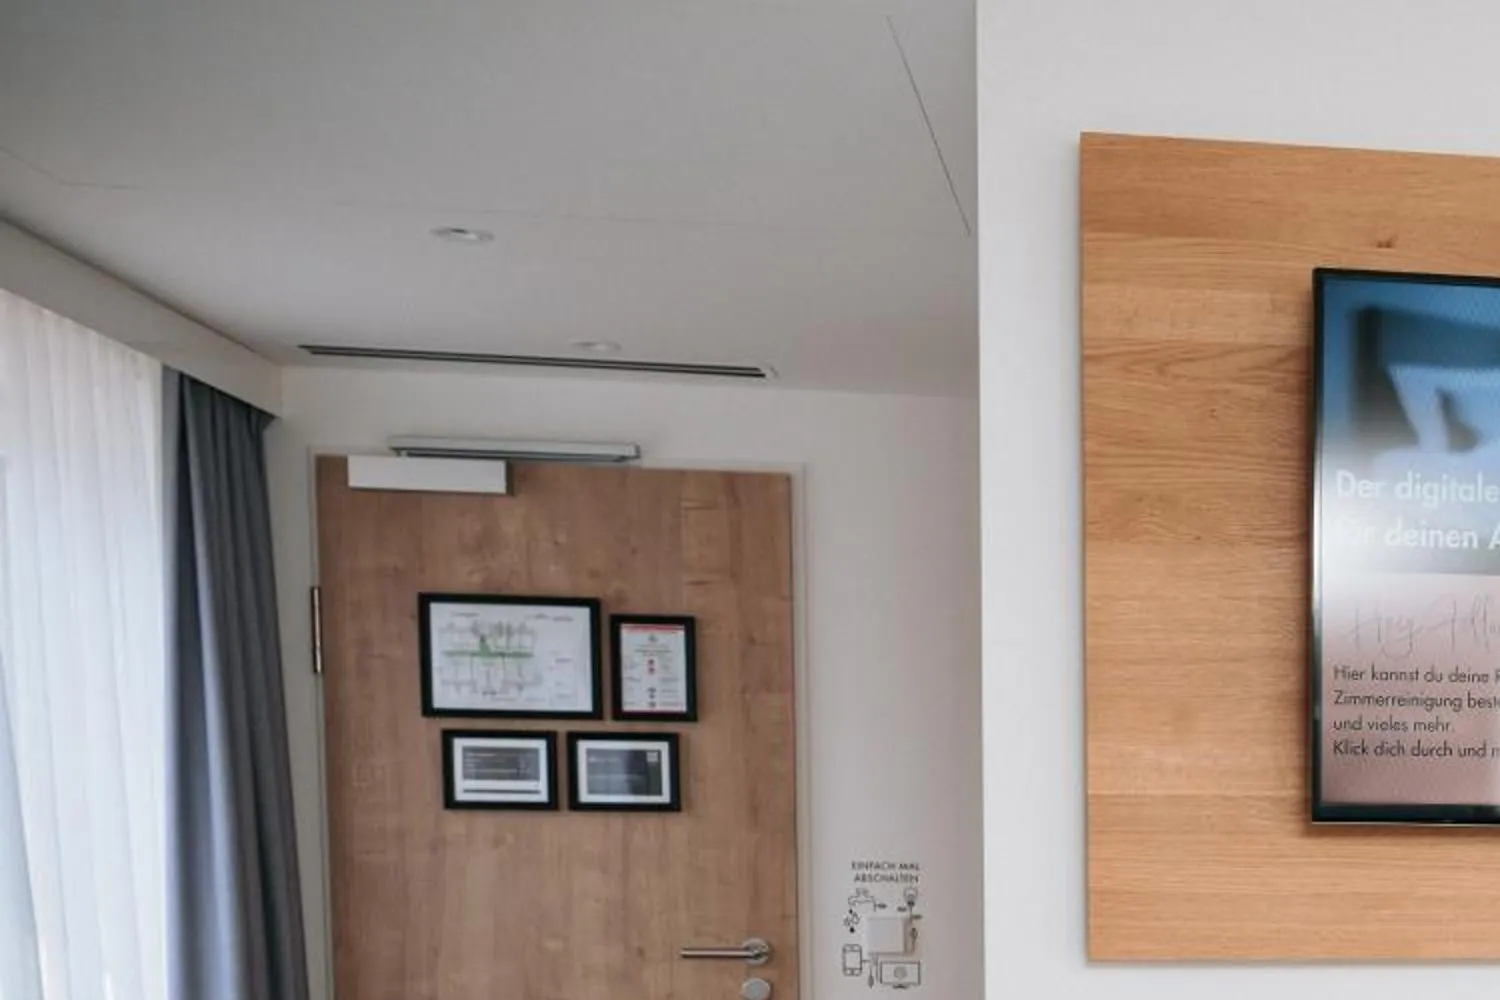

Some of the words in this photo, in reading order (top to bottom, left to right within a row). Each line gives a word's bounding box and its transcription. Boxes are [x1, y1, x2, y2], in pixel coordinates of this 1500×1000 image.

[1336, 469, 1386, 499] Der
[1383, 515, 1479, 550] deinen
[1332, 665, 1365, 682] Hier
[1371, 663, 1420, 682] kannst
[1423, 664, 1443, 683] du
[1448, 664, 1489, 683] deine
[1333, 690, 1463, 713] Zimmerreinigung
[1333, 714, 1363, 731] und
[1367, 714, 1409, 733] vieles
[1333, 739, 1369, 756] Klick
[1373, 739, 1406, 757] dich
[1411, 739, 1453, 758] durch
[1457, 739, 1487, 758] und
